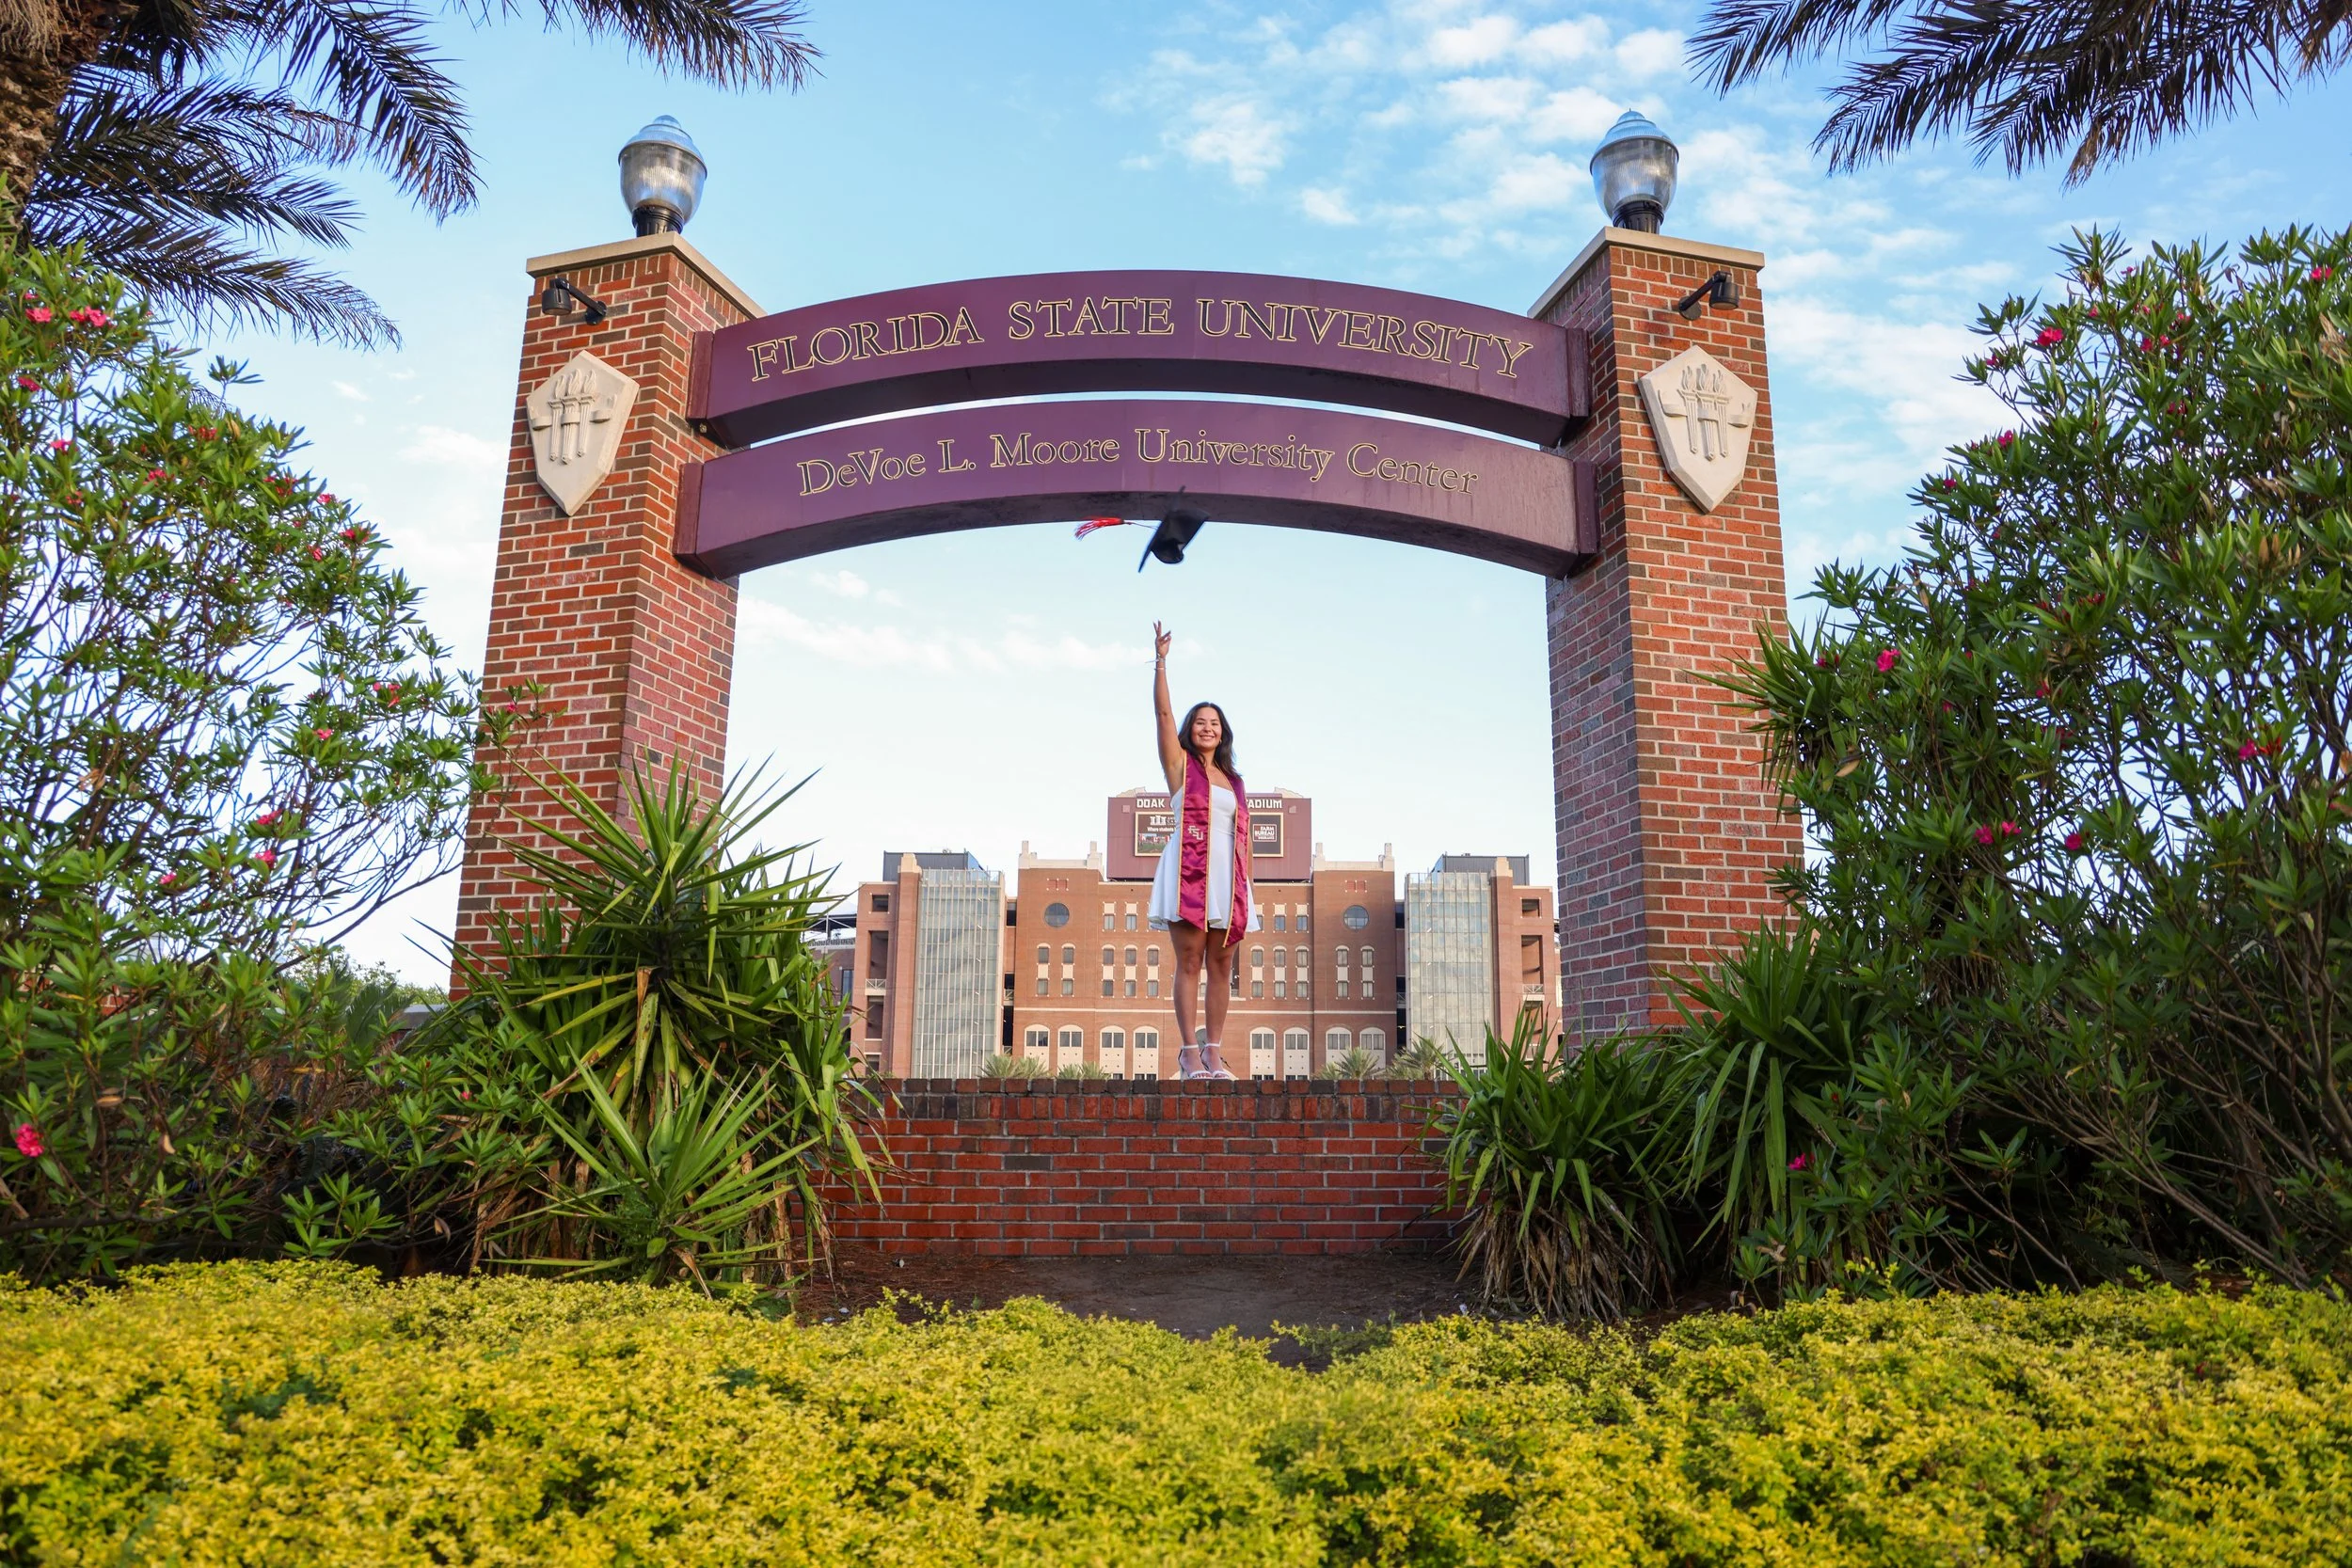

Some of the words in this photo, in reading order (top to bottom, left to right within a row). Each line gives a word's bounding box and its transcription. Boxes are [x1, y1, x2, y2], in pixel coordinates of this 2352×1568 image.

[746, 306, 985, 383] FLORIDA
[1009, 296, 1175, 341] STATE
[1196, 297, 1534, 379] UNIVERSITY
[797, 447, 926, 497] DeVoe
[937, 438, 977, 473] L.
[989, 432, 1120, 468] Moore
[1135, 428, 1335, 483] University
[1345, 443, 1479, 496] Center
[1136, 799, 1165, 808] DOAK
[1247, 799, 1282, 809] ADIUM
[1187, 825, 1204, 841] FSU
